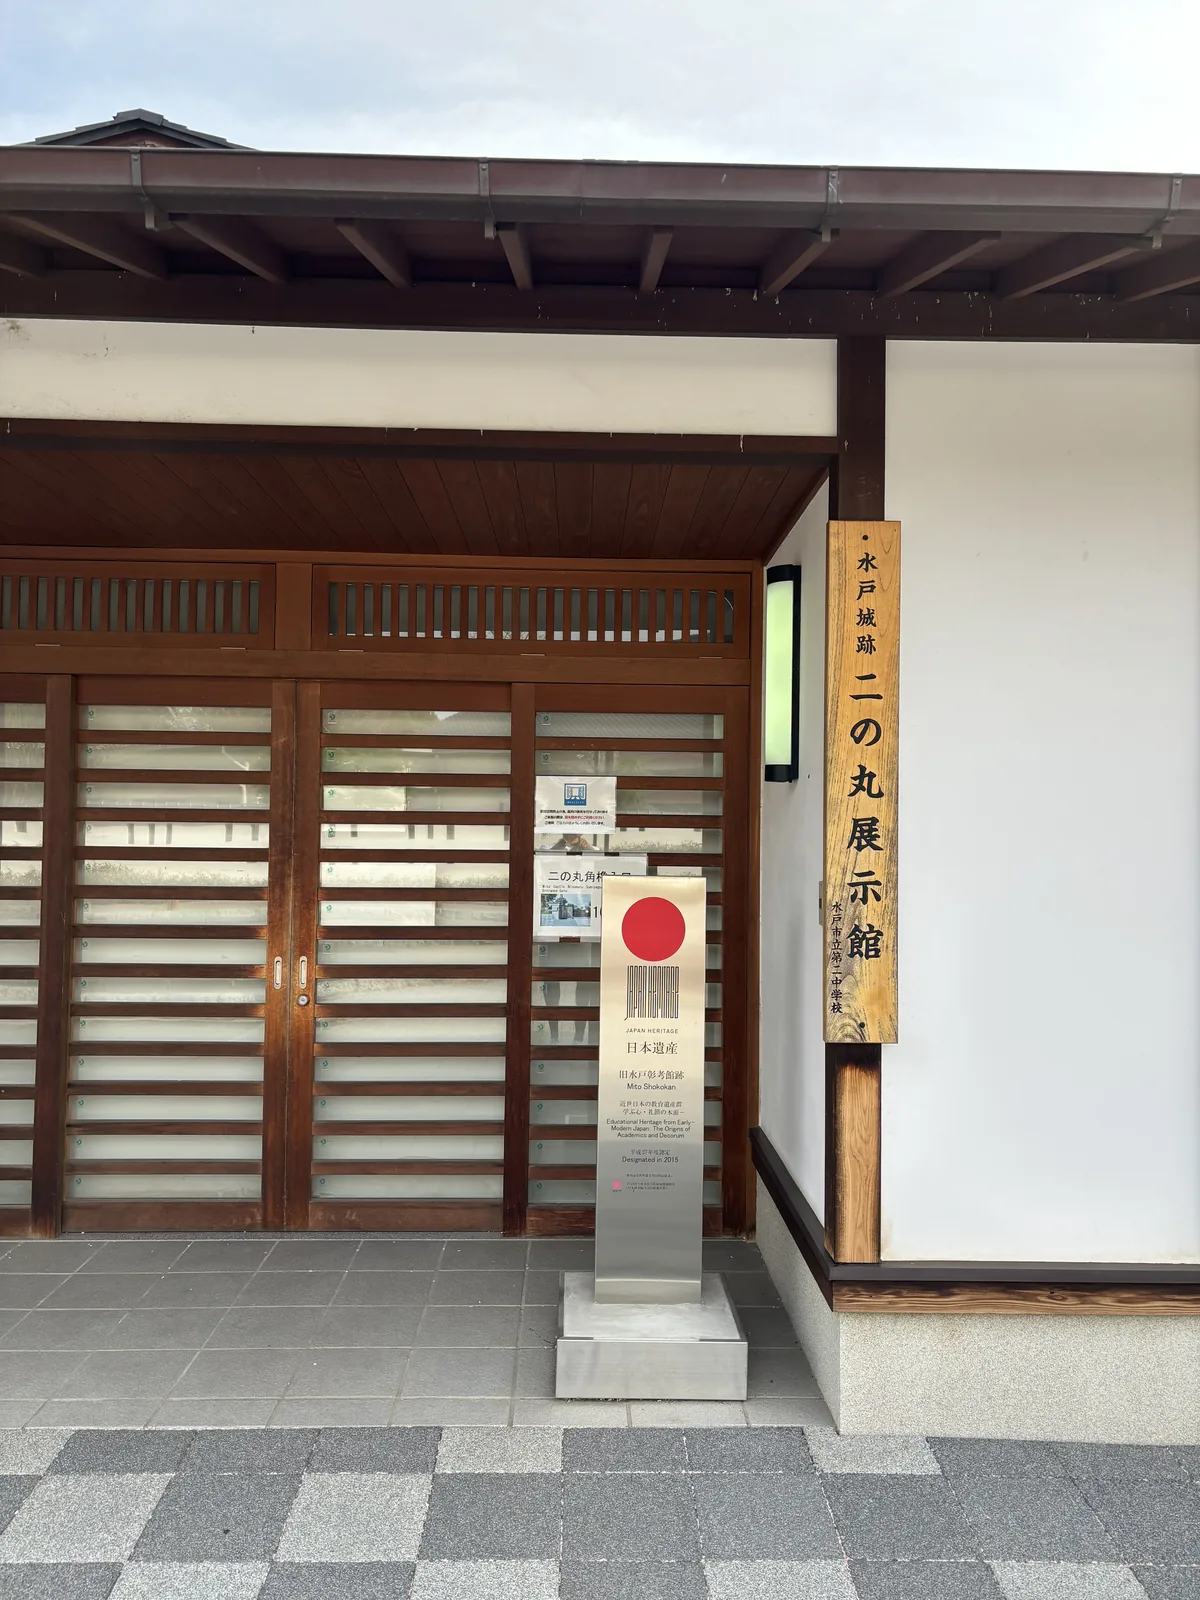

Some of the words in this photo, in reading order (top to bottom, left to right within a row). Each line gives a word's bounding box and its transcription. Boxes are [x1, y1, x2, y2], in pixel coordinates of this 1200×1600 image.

[856, 552, 878, 655] 水戸城跡
[846, 673, 884, 961] 二の丸展示館
[830, 901, 843, 1014] 水戸市立第二中学校
[619, 1070, 685, 1080] 旧水戸彰考館跡
[627, 1041, 678, 1055] 日本遺産
[640, 1118, 662, 1126] Heritage
